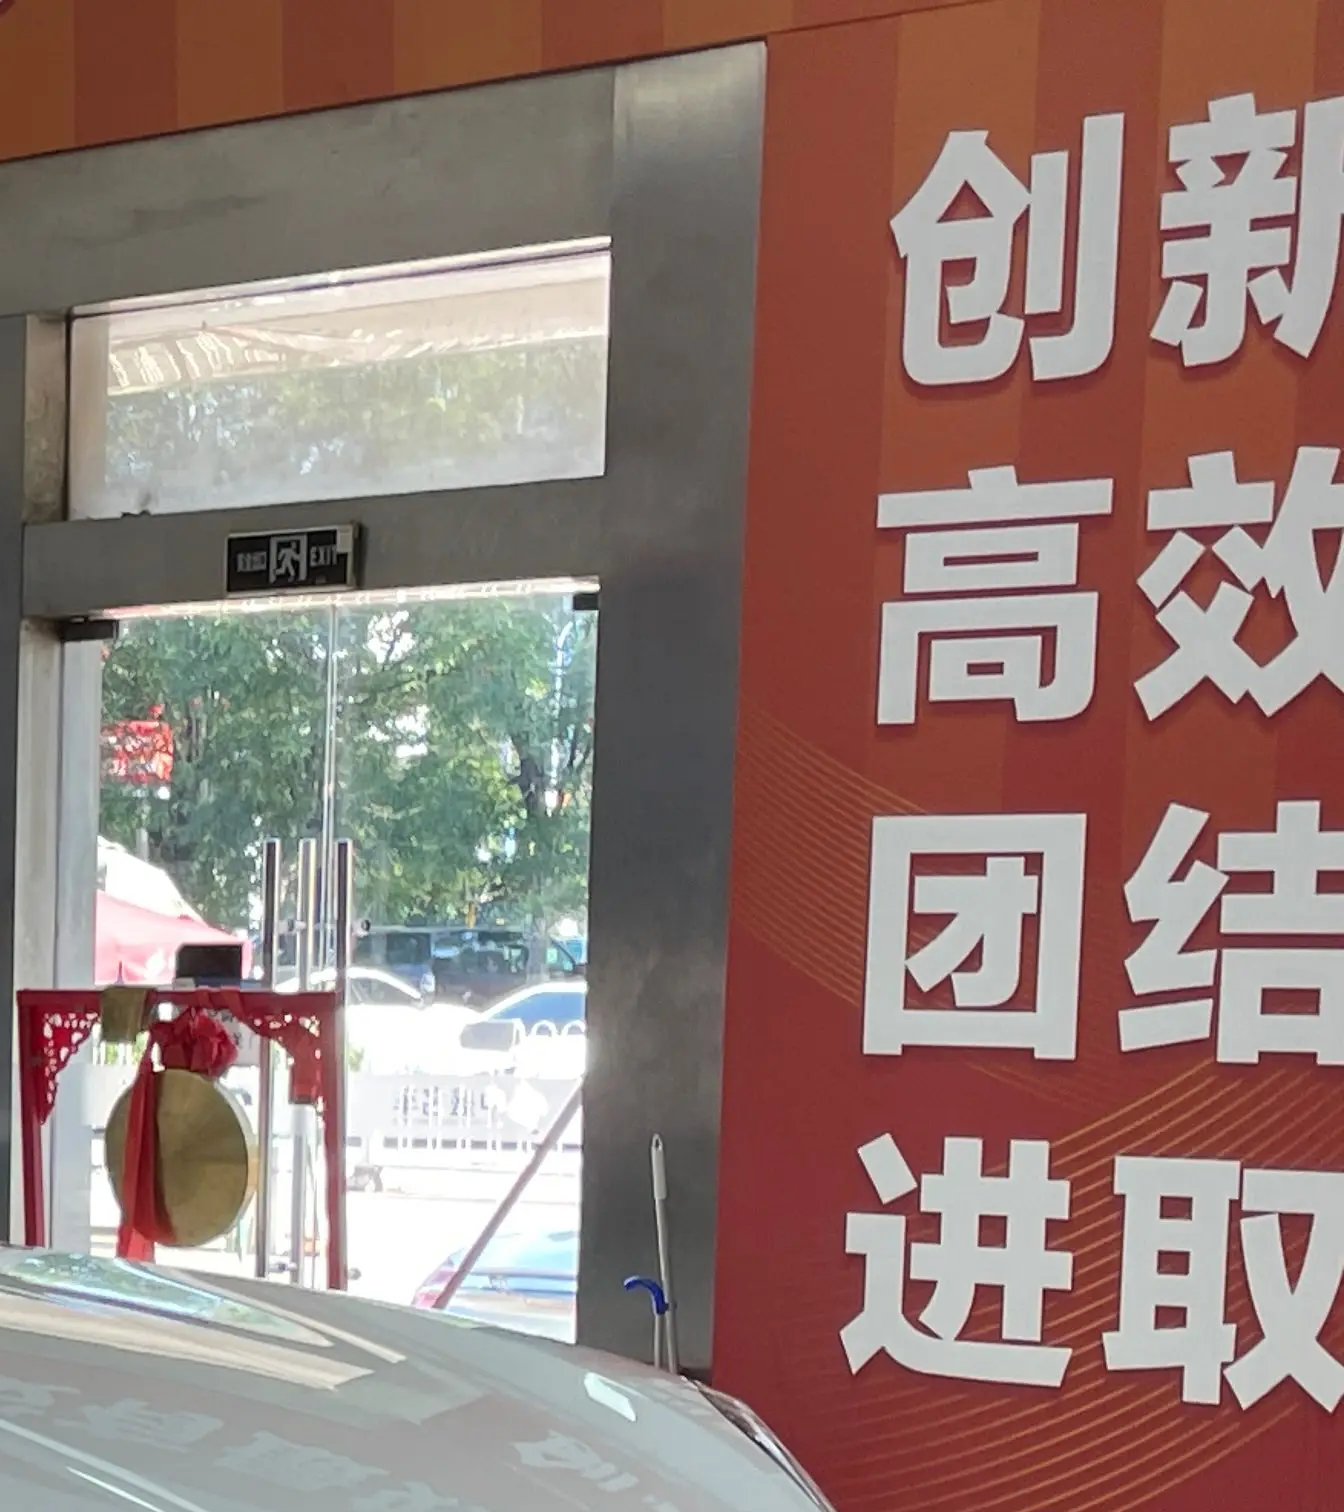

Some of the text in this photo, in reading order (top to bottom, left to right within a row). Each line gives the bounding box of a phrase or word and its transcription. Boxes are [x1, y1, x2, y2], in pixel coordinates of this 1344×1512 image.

[890, 92, 1344, 384] 创新
[876, 446, 1344, 725] 高效
[863, 800, 1344, 1066] 团结
[840, 1133, 1344, 1414] 进取
